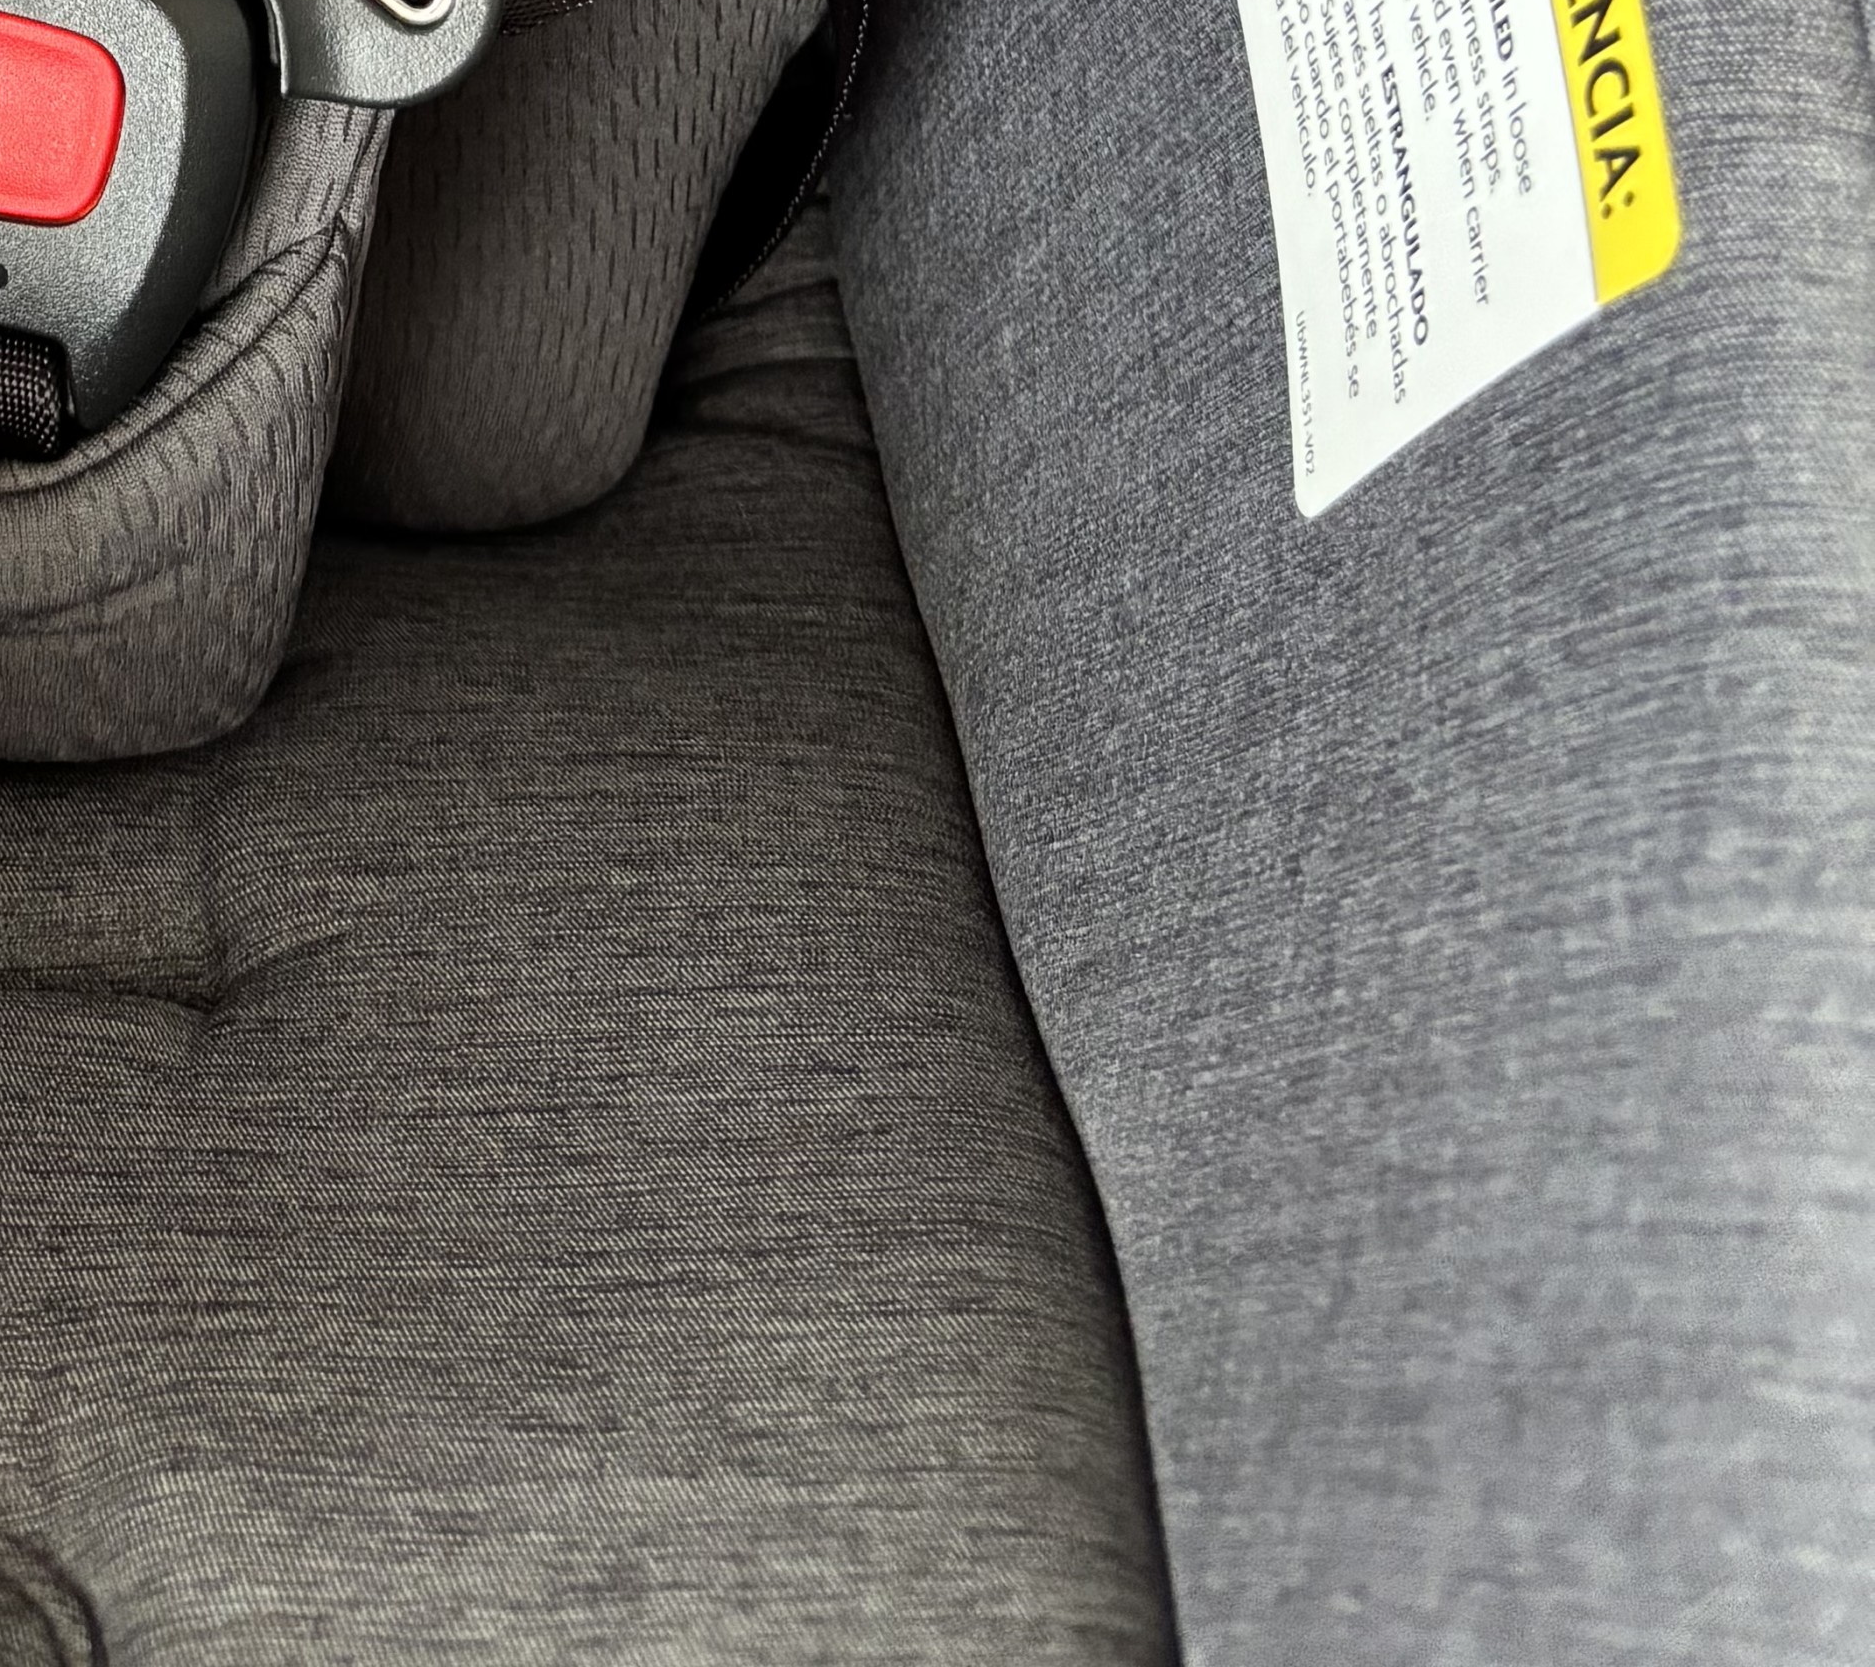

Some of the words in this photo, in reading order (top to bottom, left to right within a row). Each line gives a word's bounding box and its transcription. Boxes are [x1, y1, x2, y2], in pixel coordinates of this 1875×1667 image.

[1280, 15, 1299, 62] del
[1304, 30, 1331, 140] cuando
[1408, 4, 1438, 121] vehicle.
[1501, 66, 1518, 101] in
[1289, 64, 1317, 196] vehículo.
[1323, 146, 1340, 175] el
[1358, 82, 1383, 187] sueltas
[1368, 0, 1387, 62] han
[1380, 62, 1429, 346] ESTRANGULADO
[1438, 27, 1461, 104] even
[1452, 107, 1475, 199] when
[1466, 205, 1488, 304] carrier
[1476, 91, 1501, 193] straps.
[1508, 101, 1531, 193] loose
[1338, 97, 1378, 339] completamente
[1375, 193, 1387, 216] o
[1324, 179, 1359, 357] portabebés
[1378, 223, 1408, 404] abrochadas
[1347, 364, 1359, 398] se
